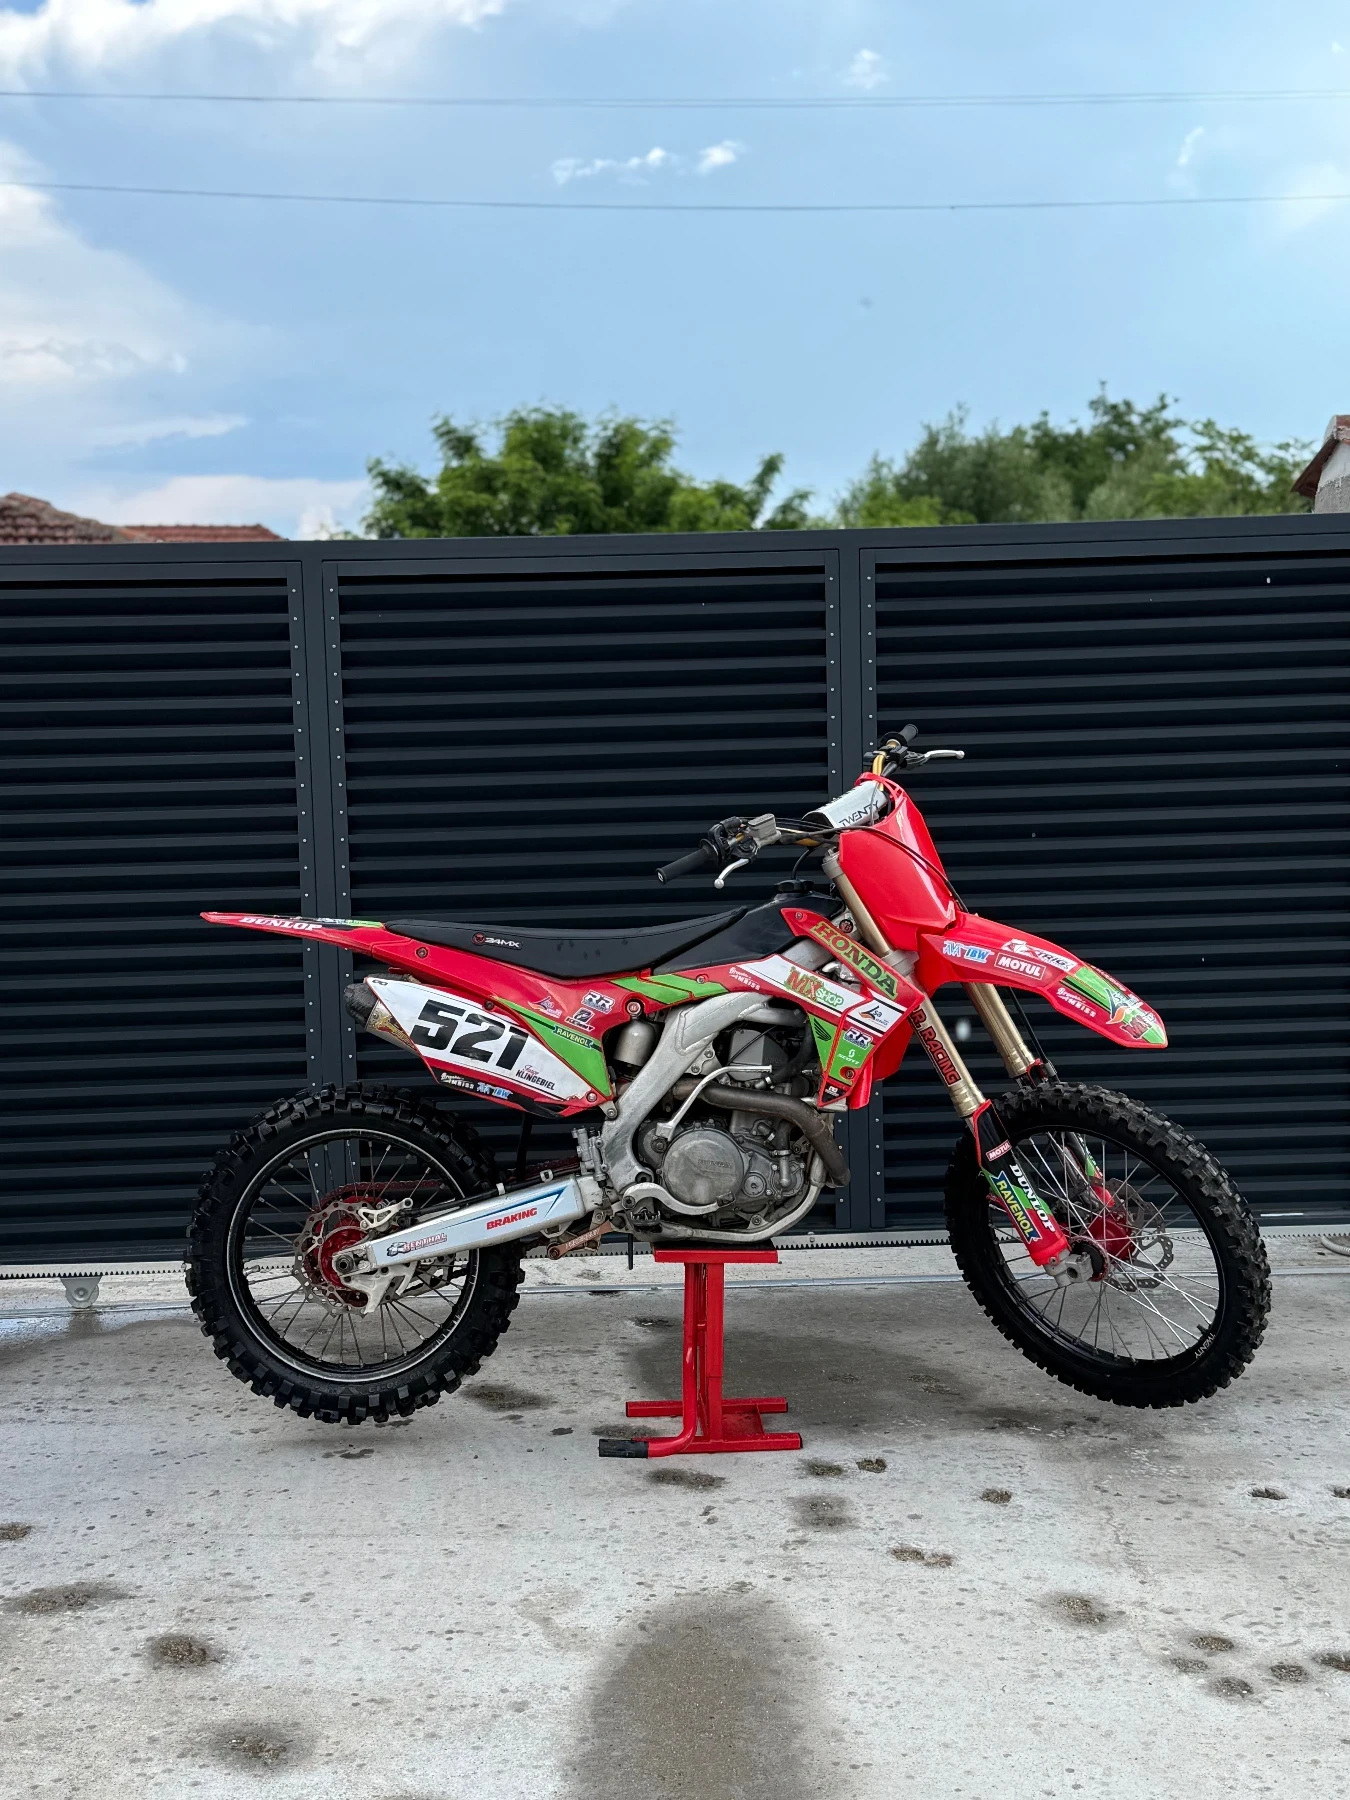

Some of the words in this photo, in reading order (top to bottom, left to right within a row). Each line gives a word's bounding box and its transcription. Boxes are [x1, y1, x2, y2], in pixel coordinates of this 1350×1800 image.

[838, 800, 880, 827] TWENTY
[239, 916, 323, 931] DUNLOP
[485, 937, 520, 948] 24MX
[813, 921, 896, 998] HONDA
[998, 956, 1041, 977] MOTUL
[816, 988, 844, 1006] SHOP
[410, 999, 529, 1071] 521
[556, 1027, 590, 1046] RAVENOL
[919, 1026, 961, 1085] RACING
[516, 1070, 555, 1091] KLINGEBIEL
[989, 1142, 1011, 1159] MOTUL
[1010, 1164, 1056, 1232] DUNLOP
[486, 1207, 537, 1230] BRAKING
[996, 1181, 1032, 1237] RAVENOL
[403, 1233, 447, 1251] RENTHAL
